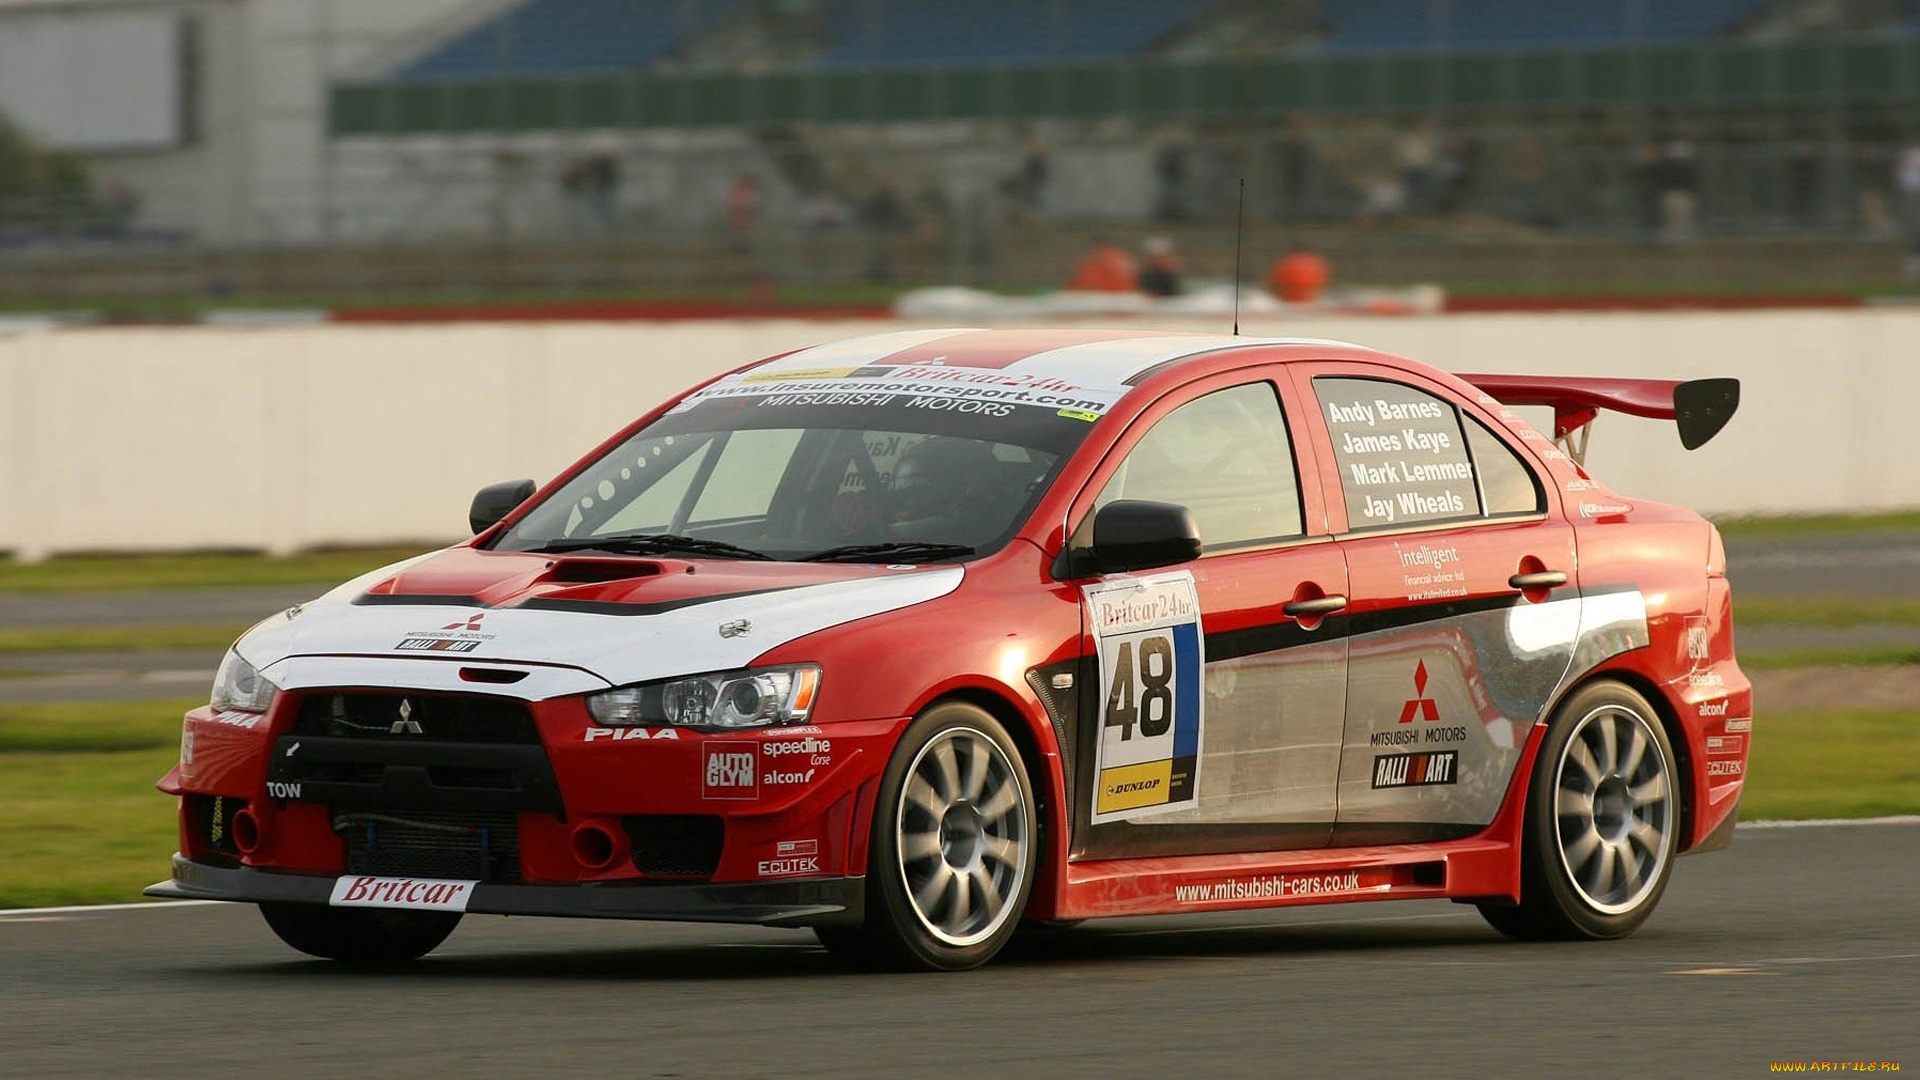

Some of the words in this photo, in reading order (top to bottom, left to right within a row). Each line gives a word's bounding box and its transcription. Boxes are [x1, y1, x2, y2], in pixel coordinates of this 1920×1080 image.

[702, 382, 1105, 411] www.insuremotorsport.com
[757, 393, 894, 408] MITSUBISHI
[906, 396, 1015, 418] MOTORS
[1329, 401, 1375, 426] Andy
[1375, 399, 1442, 420] Barnes
[1343, 431, 1400, 454] James
[1402, 429, 1450, 453] Kaye
[1350, 462, 1401, 486] Mark
[1402, 460, 1473, 482] Lemmer
[1364, 494, 1394, 521] Jay
[1396, 491, 1464, 515] Wheals
[1395, 541, 1460, 569] intelligent
[404, 631, 453, 639] MITSUBISHI
[457, 632, 496, 640] MOTORS
[1105, 636, 1172, 741] 48
[1699, 701, 1721, 716] alcon
[584, 727, 680, 742] PIAA
[1370, 729, 1419, 747] MITSUBISHI
[1425, 726, 1467, 742] MOTORS
[763, 737, 831, 757] speedline
[708, 753, 753, 771] AUTO
[810, 754, 831, 765] Corse
[1376, 755, 1410, 786] RALLI
[1425, 753, 1454, 782] ART
[707, 769, 754, 787] GLYM
[764, 771, 805, 784] alcon
[1114, 779, 1160, 794] DUNLOP
[267, 782, 300, 799] TOW
[758, 857, 820, 875] ECUTEK
[342, 877, 464, 905] Britcar
[1176, 872, 1360, 901] www.mitsubishi-cars.co.uk
